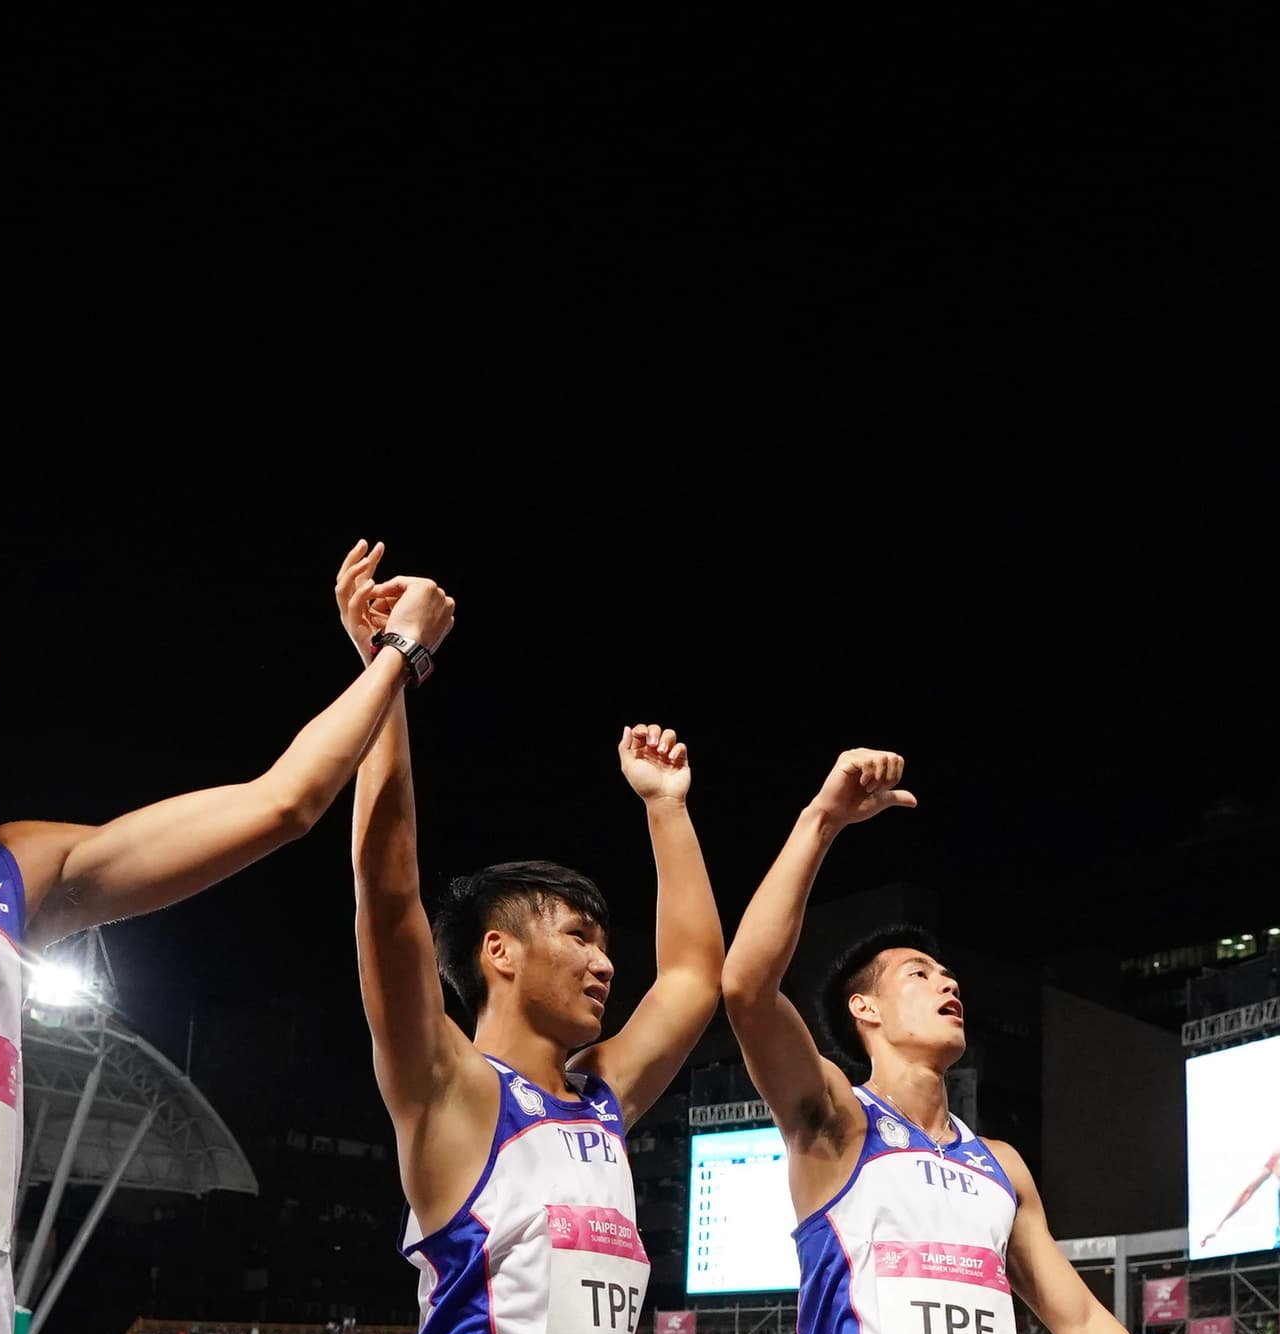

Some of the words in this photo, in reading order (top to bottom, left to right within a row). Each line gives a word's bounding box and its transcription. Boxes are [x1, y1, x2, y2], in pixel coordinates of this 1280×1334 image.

[557, 1127, 617, 1164] TPE
[916, 1158, 979, 1196] TPE
[587, 1219, 617, 1236] TAIPEI
[919, 1252, 957, 1265] TAIPEI
[959, 1256, 984, 1269] 2017
[581, 1279, 640, 1333] TPE
